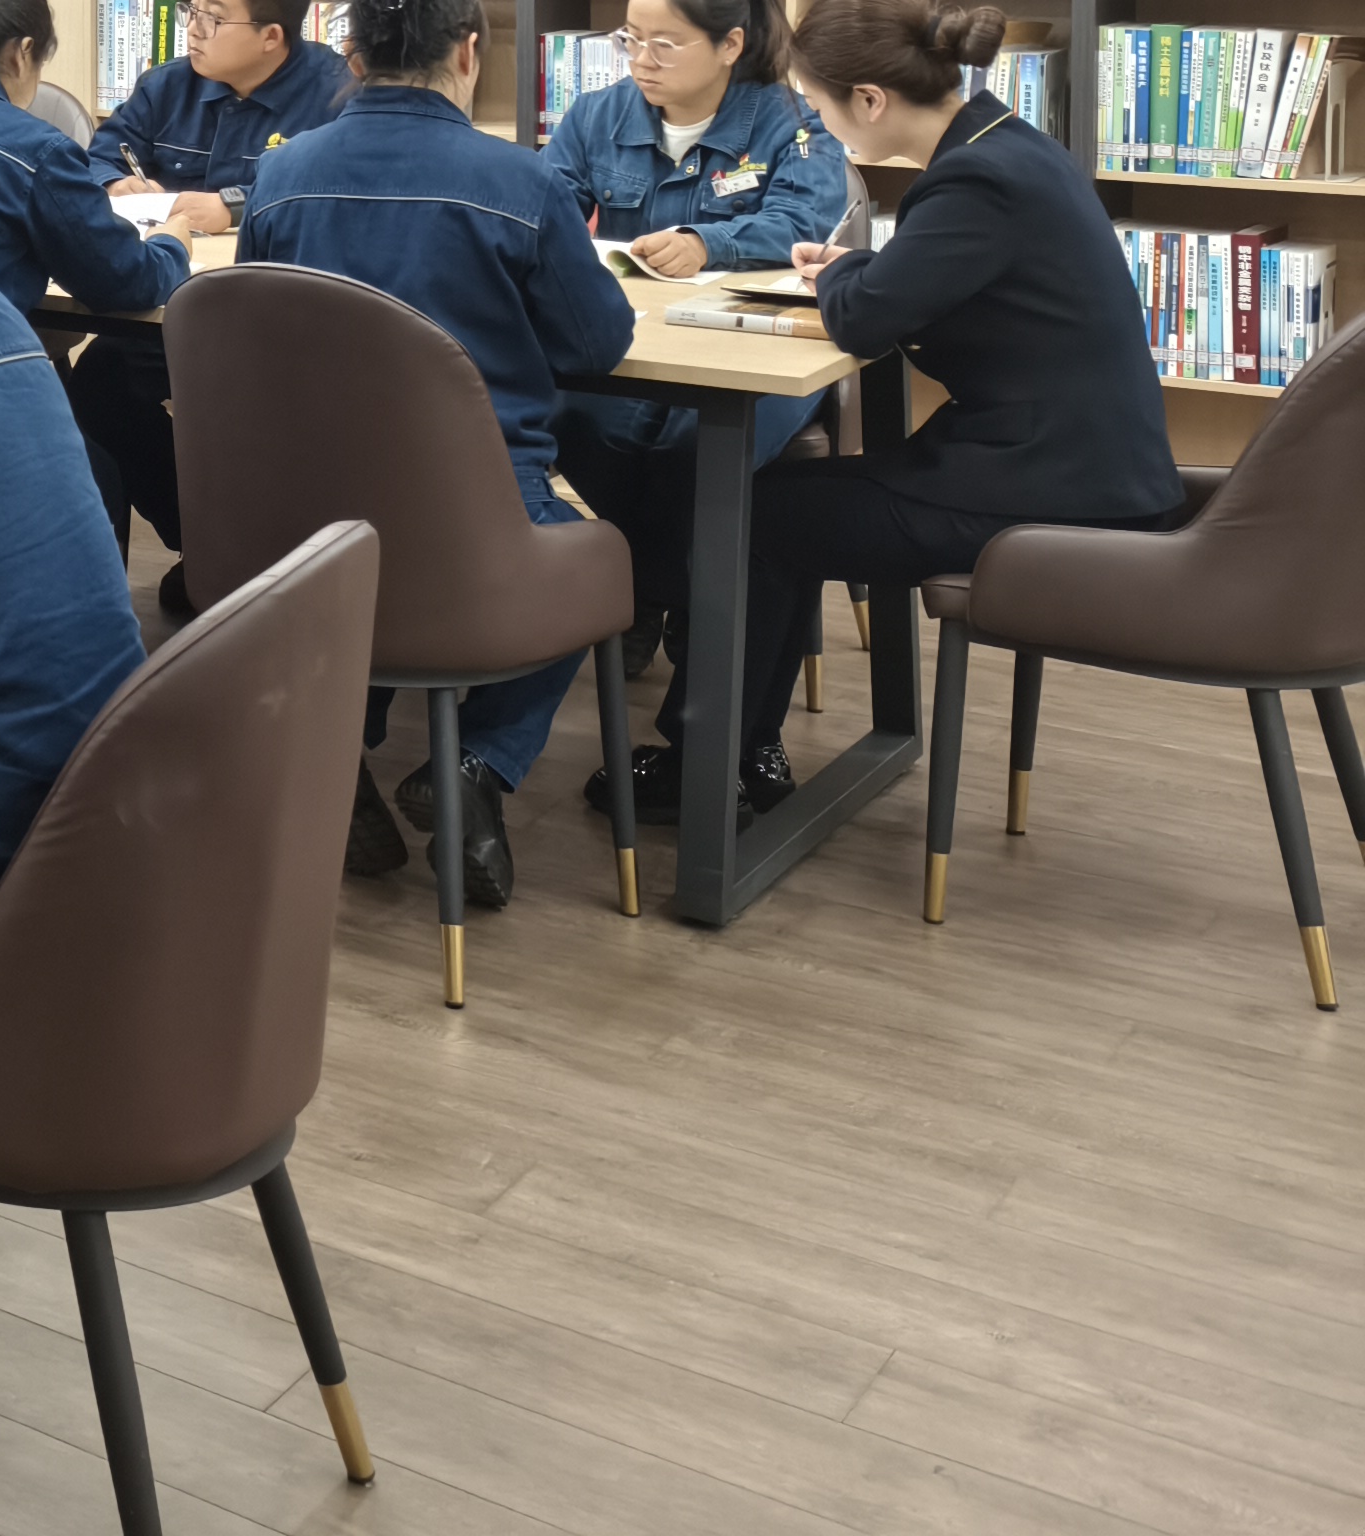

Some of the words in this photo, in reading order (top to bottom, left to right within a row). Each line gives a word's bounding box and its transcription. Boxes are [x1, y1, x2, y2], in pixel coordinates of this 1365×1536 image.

[1255, 41, 1275, 94] 钛及钛合金
